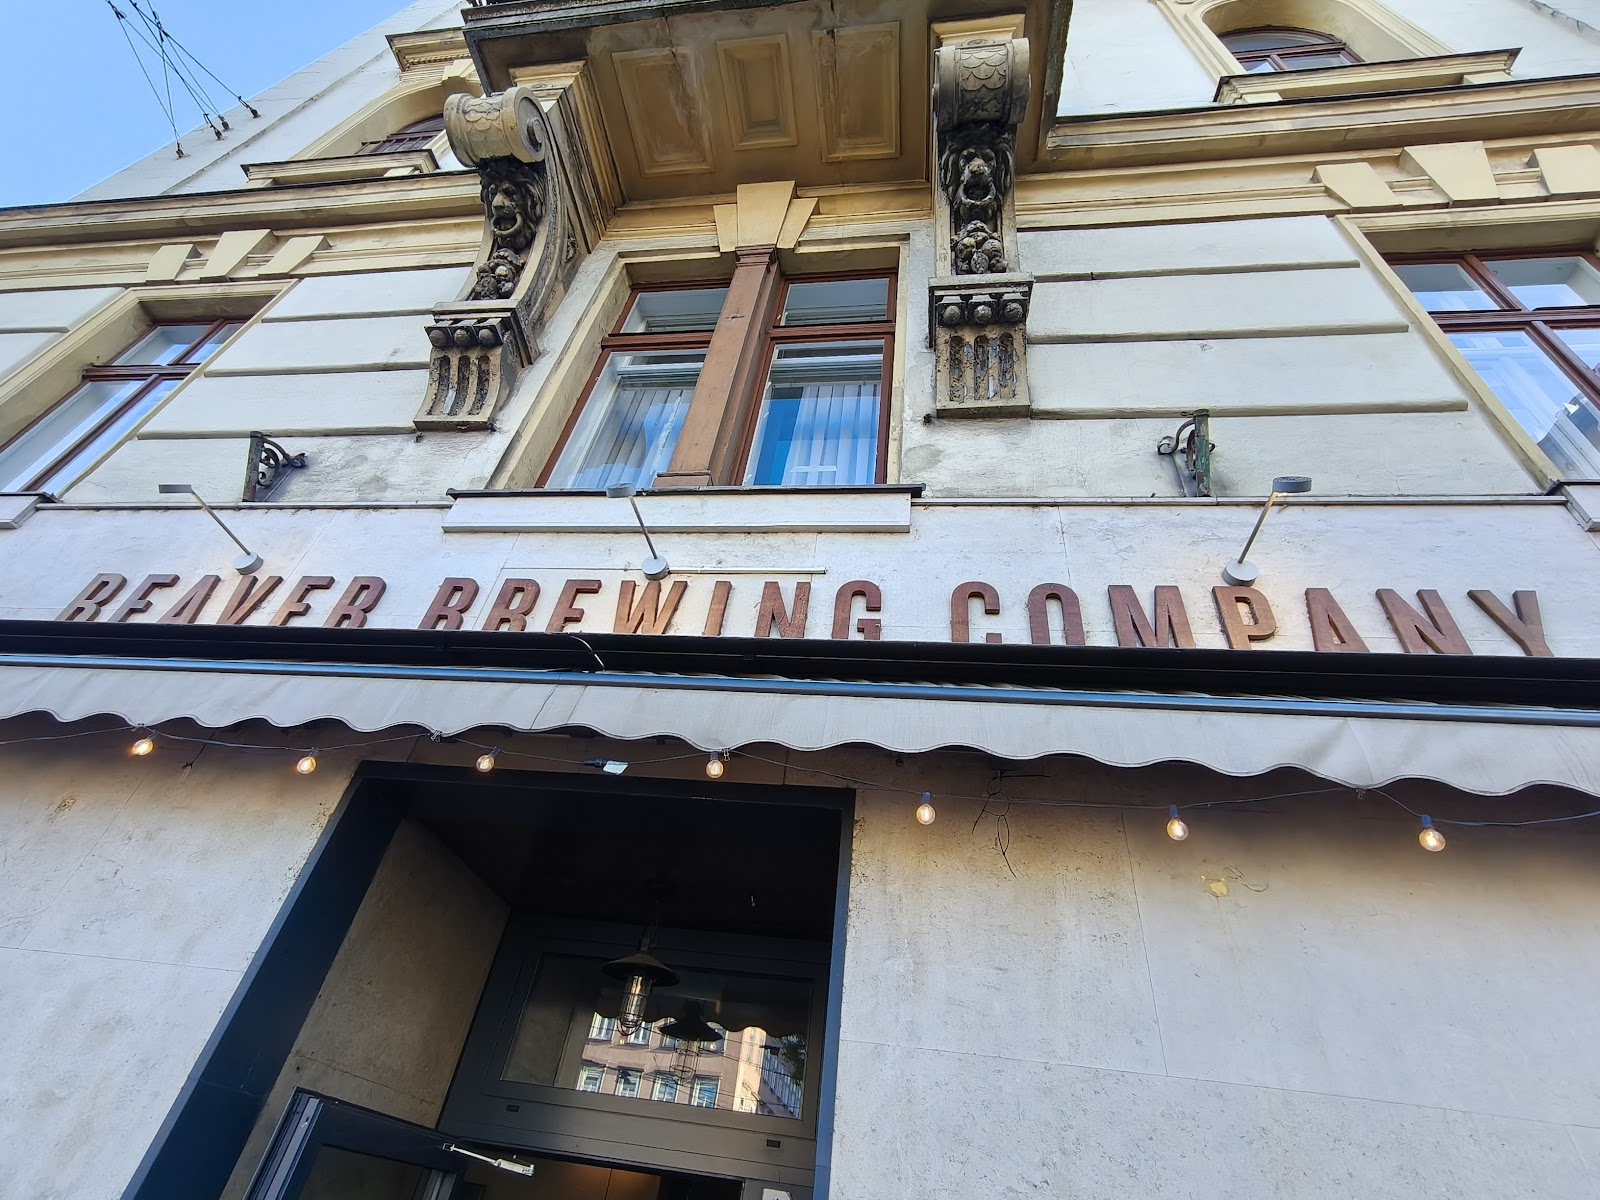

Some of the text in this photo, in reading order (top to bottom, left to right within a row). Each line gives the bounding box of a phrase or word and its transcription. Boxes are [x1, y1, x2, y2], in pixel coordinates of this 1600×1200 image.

[56, 572, 1555, 657] BEAVER BREWING COMPANY
